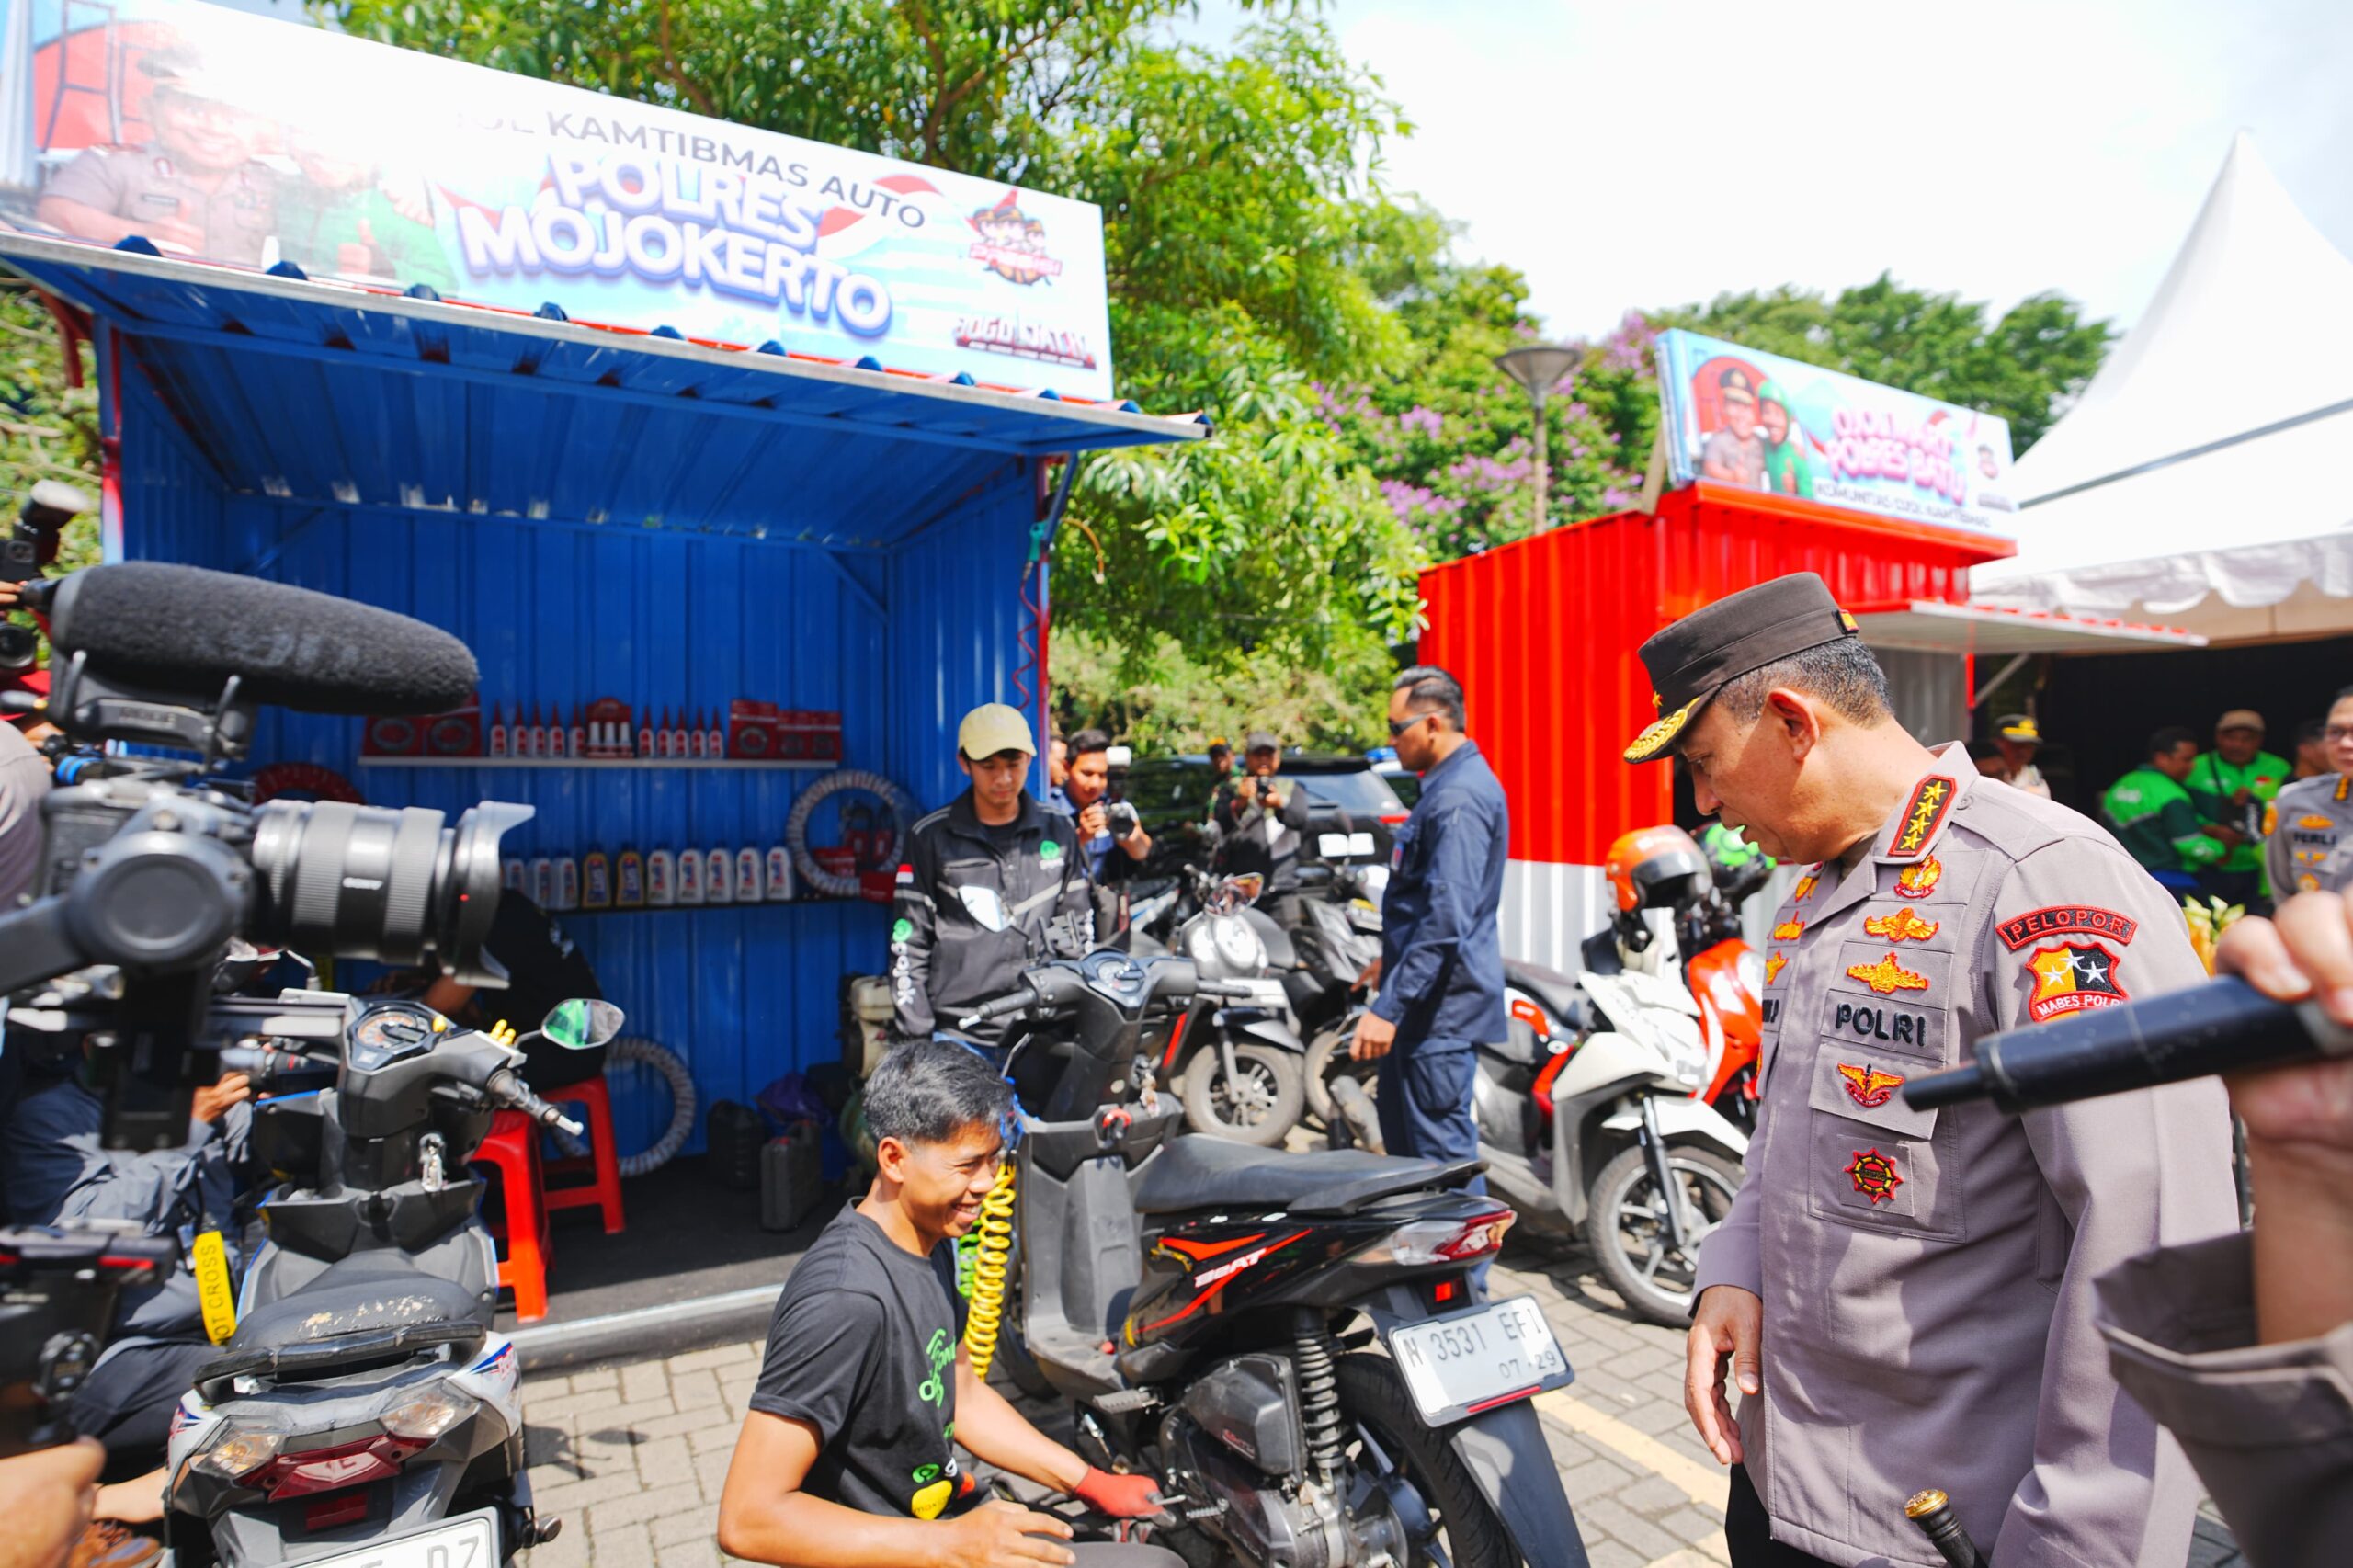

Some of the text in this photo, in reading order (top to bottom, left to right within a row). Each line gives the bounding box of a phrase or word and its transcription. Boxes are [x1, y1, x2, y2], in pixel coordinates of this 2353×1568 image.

[546, 110, 809, 187] KAMTIBMAS
[819, 176, 925, 228] AUTO
[548, 153, 819, 253] POLRES
[456, 204, 892, 336] MOJOKERTO
[2010, 909, 2125, 941] PELOPOR
[891, 941, 916, 1006] gojek
[2036, 994, 2125, 1017] MABES POLR
[1835, 1002, 1927, 1047] POLRI
[200, 1243, 224, 1310] CROSS
[1429, 1322, 1488, 1361] 3531
